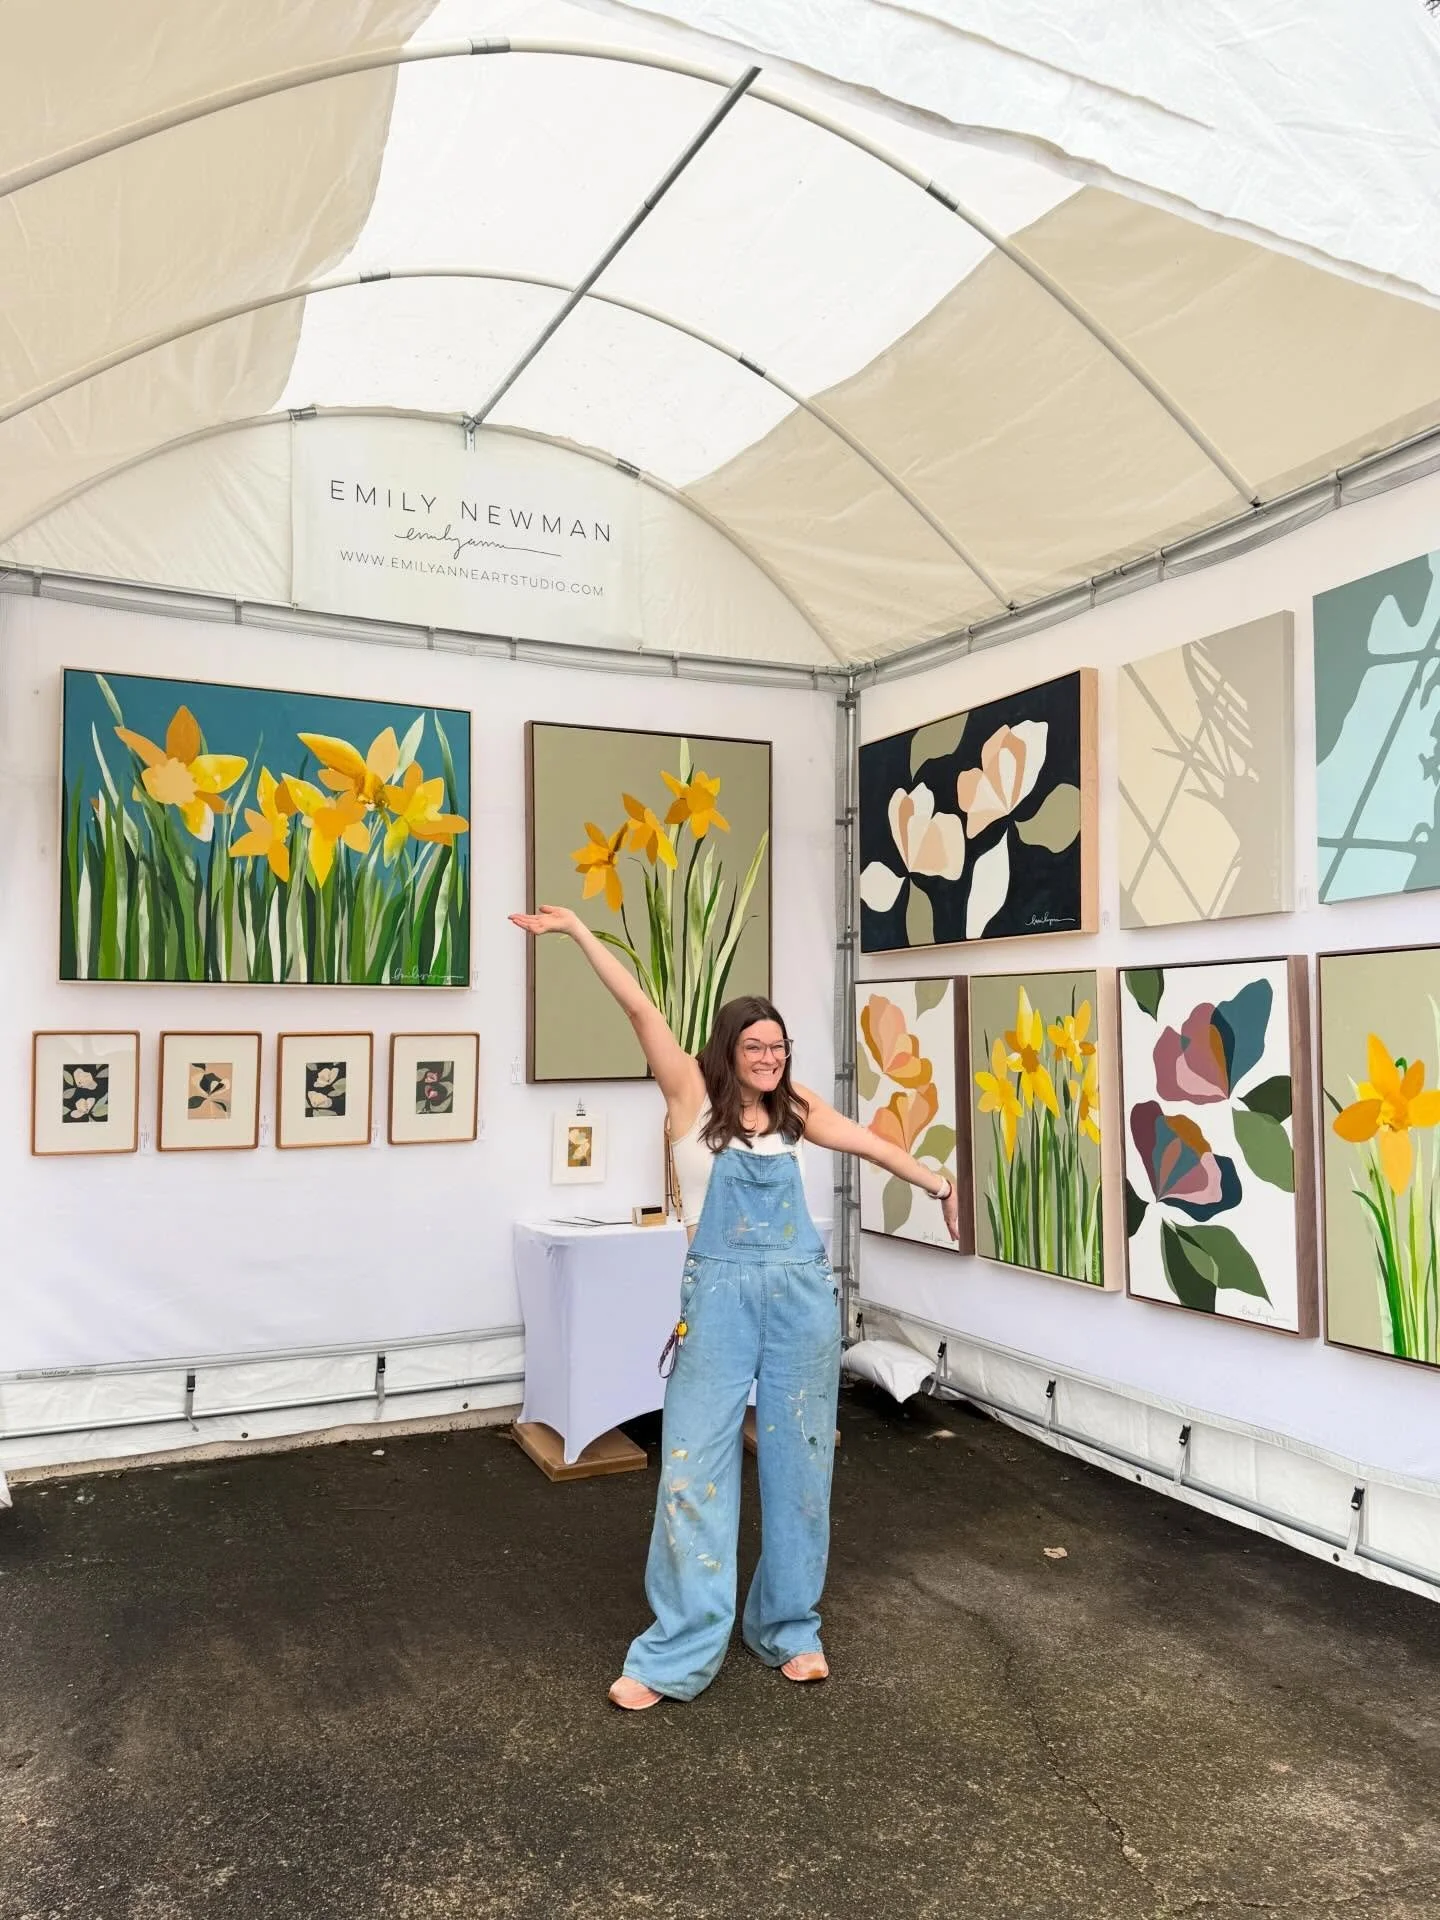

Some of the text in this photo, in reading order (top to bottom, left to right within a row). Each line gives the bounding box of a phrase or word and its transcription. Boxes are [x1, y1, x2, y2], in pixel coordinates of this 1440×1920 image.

[330, 479, 611, 542] EMILY NEWMAN
[339, 550, 604, 597] WWW.EMILYANNEARTSTUDIO.COM
